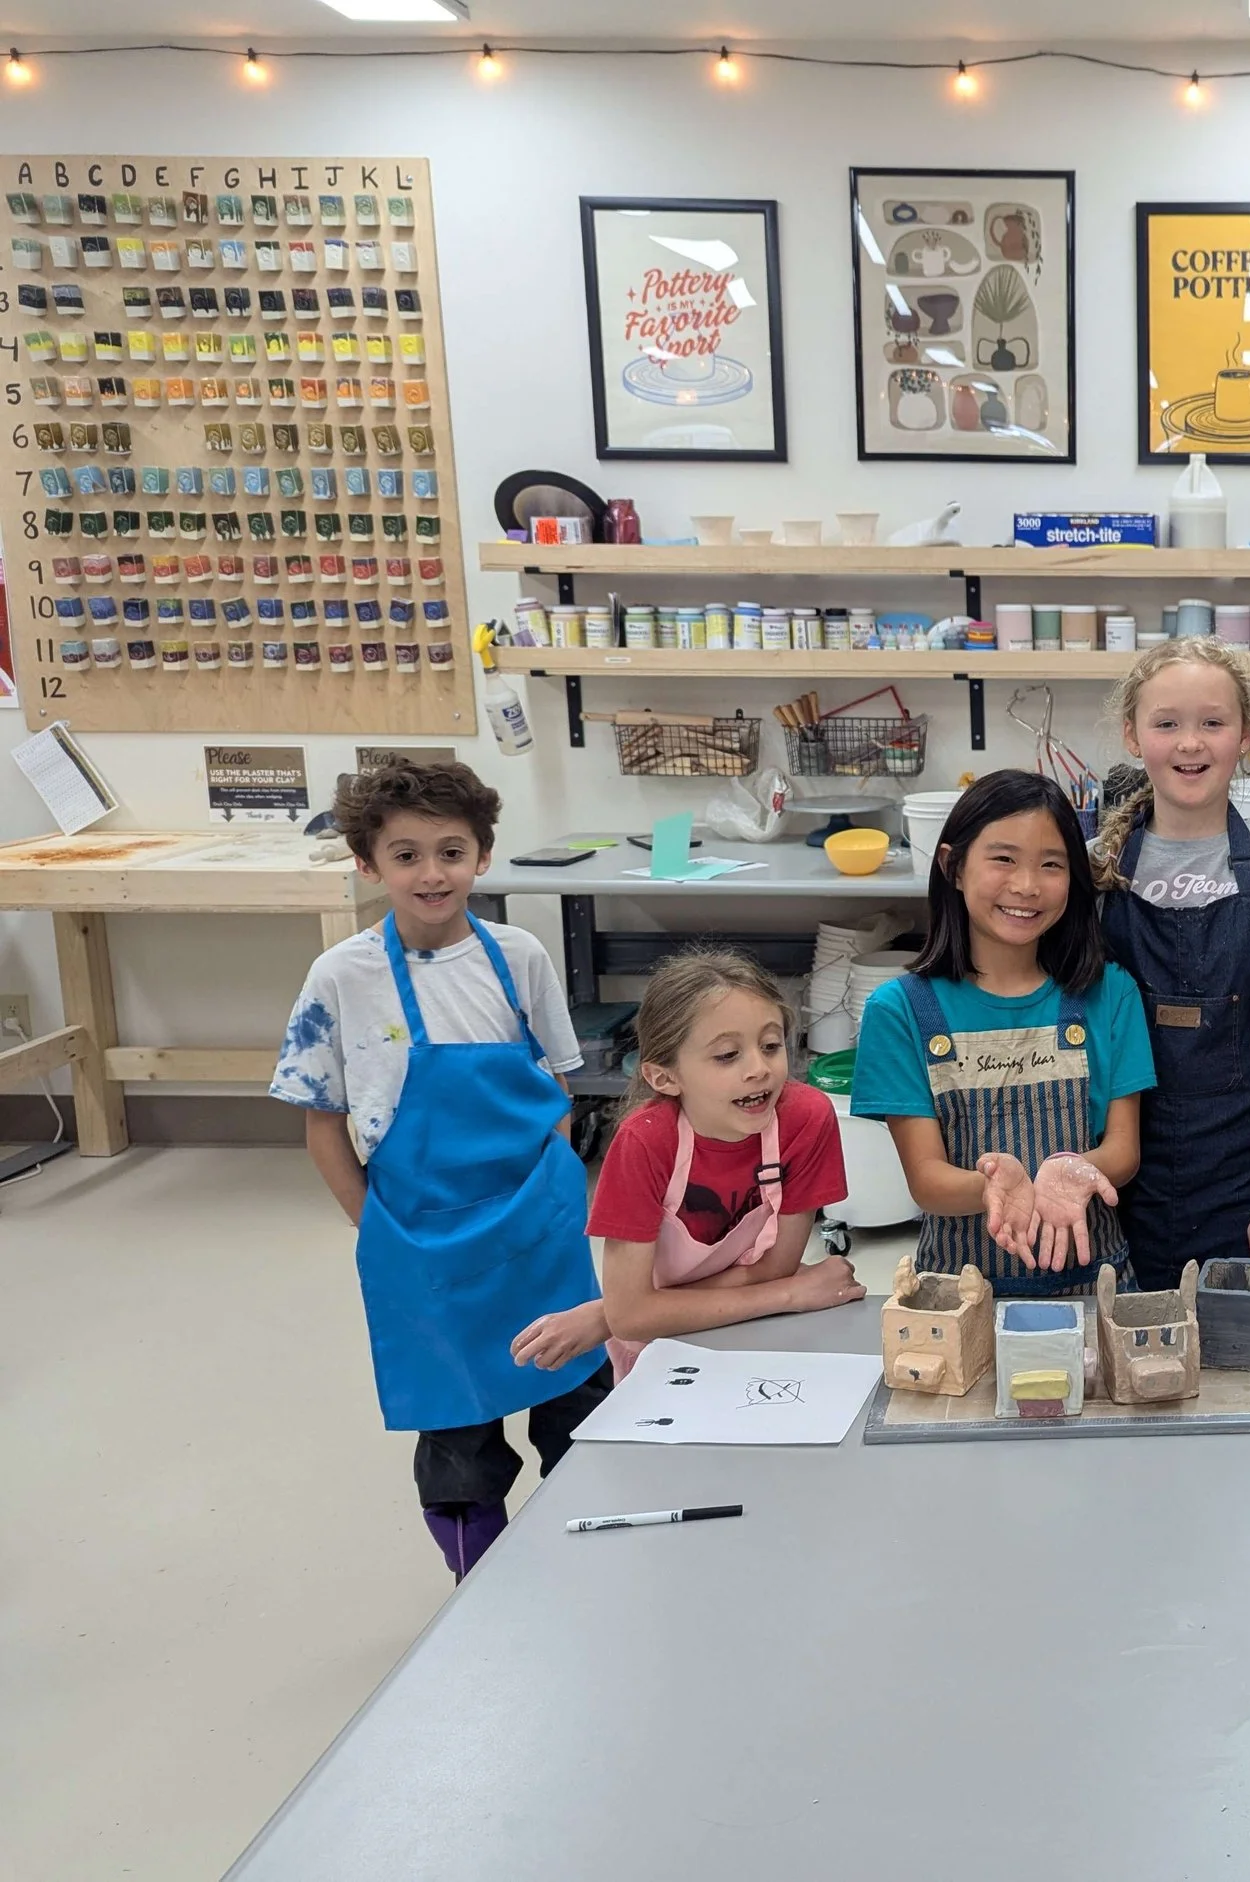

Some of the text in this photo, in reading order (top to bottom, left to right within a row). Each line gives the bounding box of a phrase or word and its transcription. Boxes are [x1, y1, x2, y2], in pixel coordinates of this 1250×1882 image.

[18, 162, 413, 190] A B C D E F G H I J K L
[642, 268, 736, 305] Pottery
[667, 299, 695, 311] IS MY
[625, 300, 742, 341] Favorite
[0, 336, 18, 362] 4
[5, 382, 22, 405] 5
[12, 423, 29, 448] 6
[15, 471, 33, 496] 7
[22, 511, 39, 539] 8
[1016, 517, 1042, 528] 3000
[1046, 527, 1122, 543] stretch-tite
[28, 560, 44, 584] 9
[30, 596, 54, 619] 10
[36, 638, 54, 662] 11
[41, 677, 67, 698] 12
[206, 747, 253, 765] Please
[359, 747, 394, 765] Plea
[250, 776, 274, 784] YOUR
[275, 776, 296, 784] CLAY
[276, 769, 302, 777] THAT'S
[1170, 873, 1240, 900] Team
[977, 1051, 1056, 1074] Shining bear
